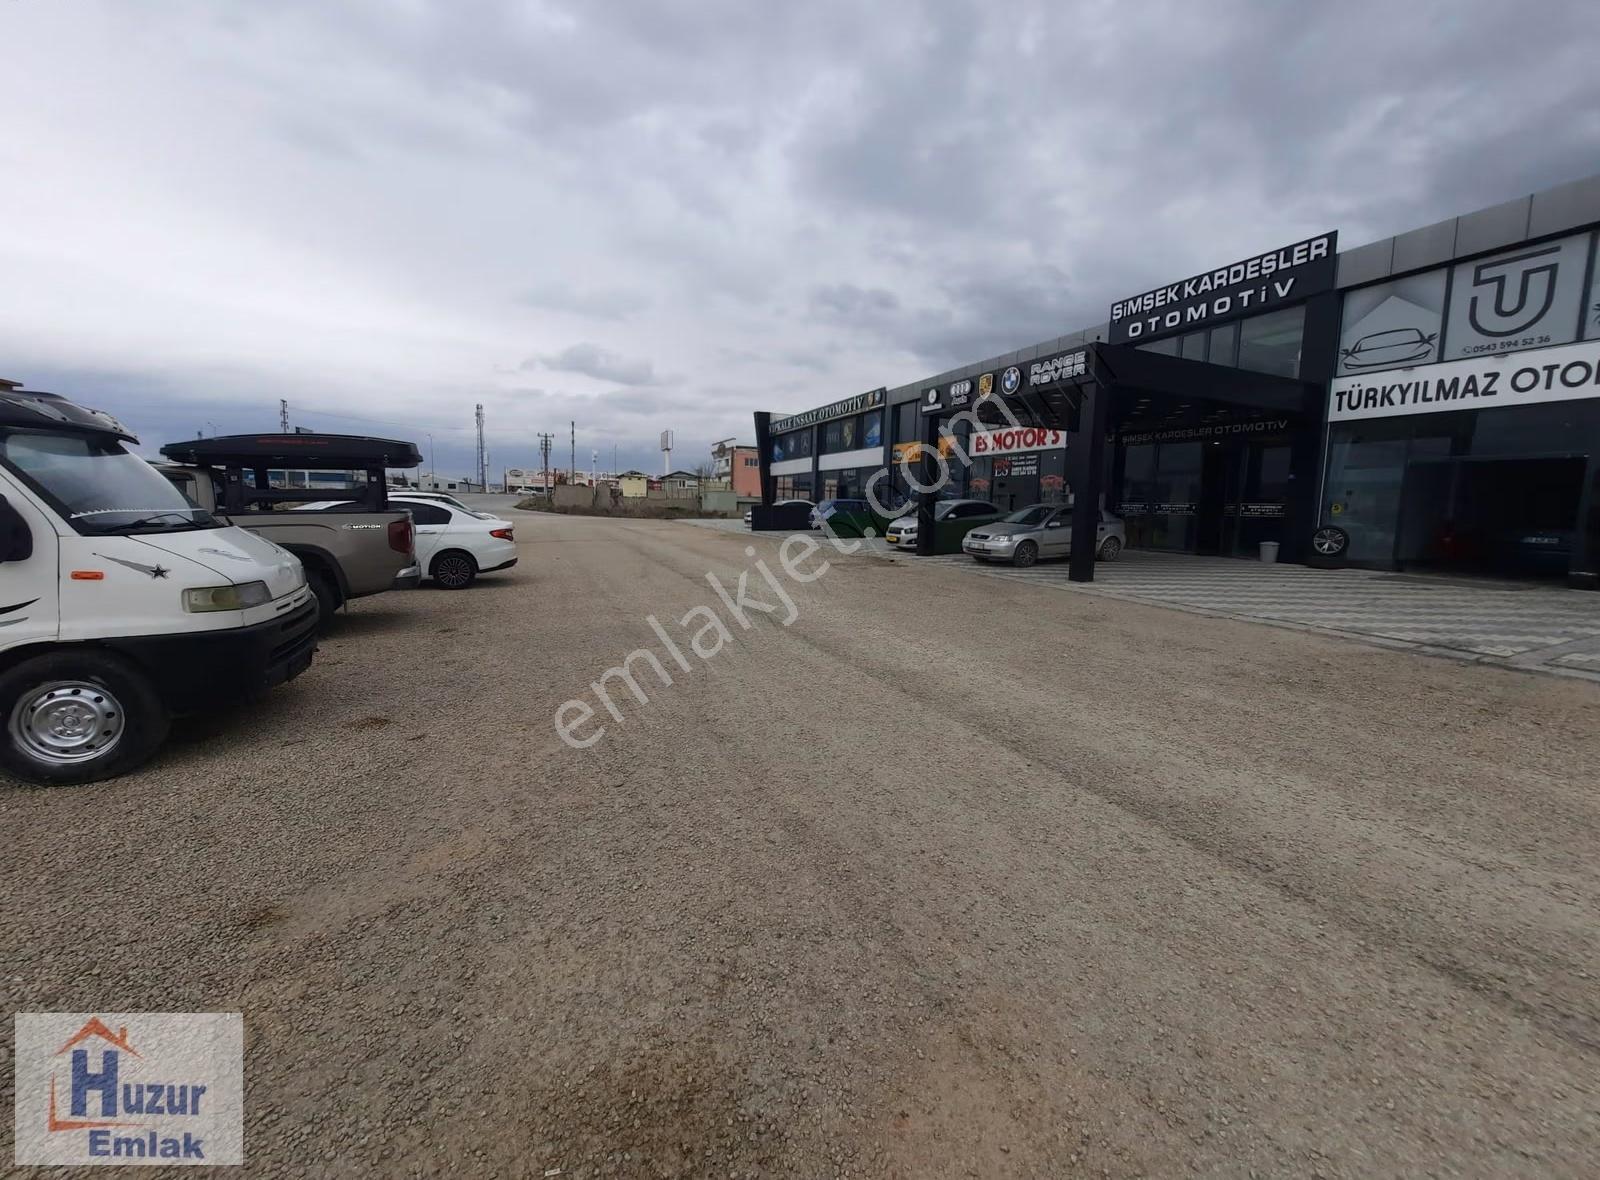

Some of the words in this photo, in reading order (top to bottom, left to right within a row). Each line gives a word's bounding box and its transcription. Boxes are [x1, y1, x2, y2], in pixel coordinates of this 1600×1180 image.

[1184, 237, 1329, 298] KARDEŞLER
[1473, 343, 1497, 353] 0543
[1500, 340, 1519, 349] 594
[1522, 337, 1535, 346] 52
[1537, 334, 1551, 344] 36
[1029, 363, 1086, 386] ROVER
[1030, 351, 1086, 375] RANGE
[1336, 371, 1501, 412] TÜRKYILMAZ
[1510, 359, 1600, 393] OTO
